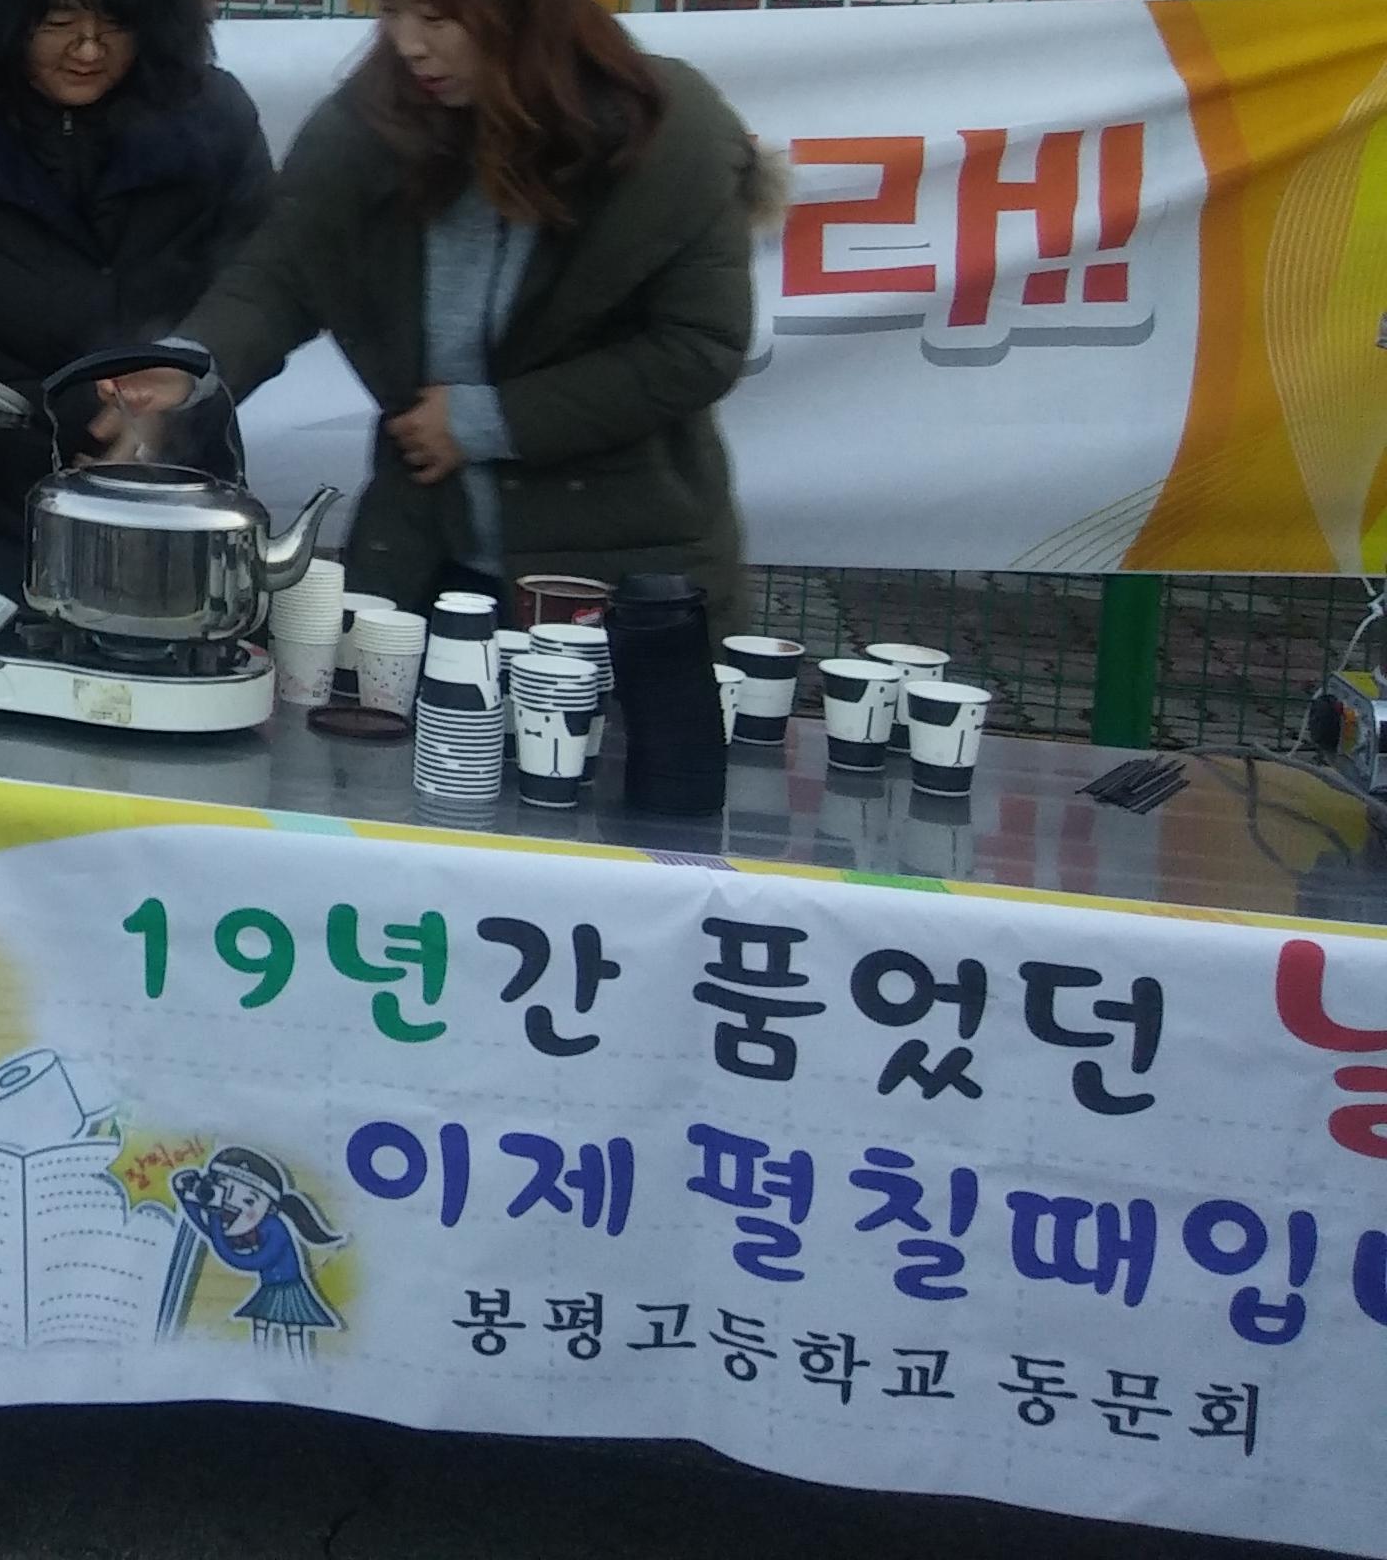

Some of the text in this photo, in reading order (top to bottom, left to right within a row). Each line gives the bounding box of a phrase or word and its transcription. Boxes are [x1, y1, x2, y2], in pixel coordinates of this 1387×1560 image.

[747, 121, 1146, 329] 래!!
[122, 896, 623, 1058] 19년간
[692, 915, 1166, 1117] 품었던
[346, 1120, 1387, 1347] 이제 펼칠때입
[451, 1287, 1264, 1458] 봉평고등학교 동문회
